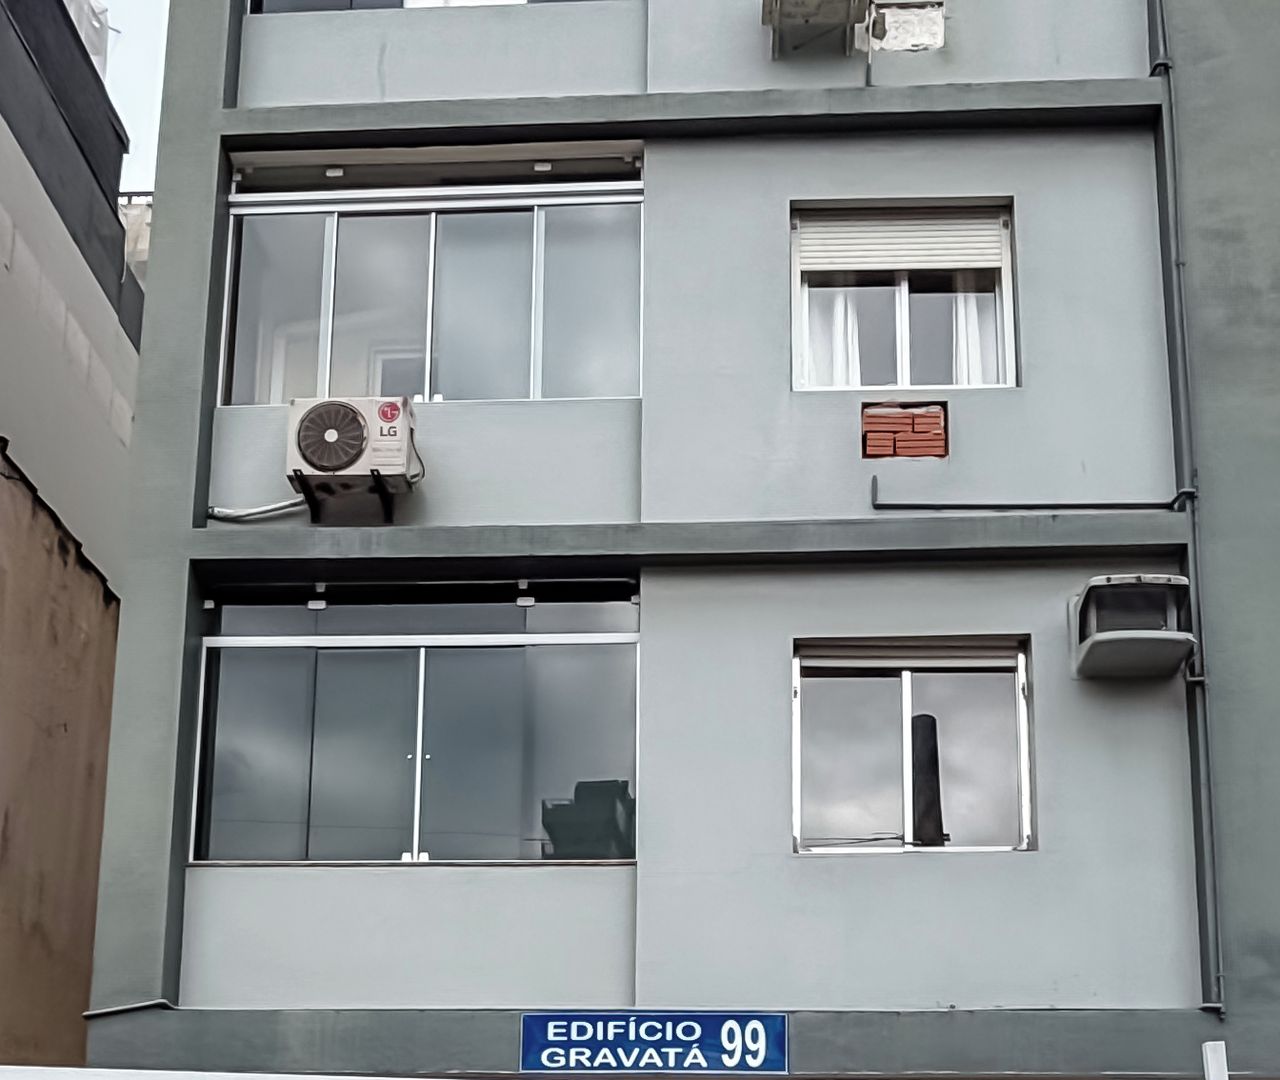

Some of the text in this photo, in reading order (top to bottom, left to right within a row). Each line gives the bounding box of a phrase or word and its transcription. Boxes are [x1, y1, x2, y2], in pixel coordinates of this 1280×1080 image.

[379, 426, 397, 437] LG
[547, 1017, 702, 1041] EDIFÍCIO
[540, 1019, 767, 1068] GRAVATÁ 99
